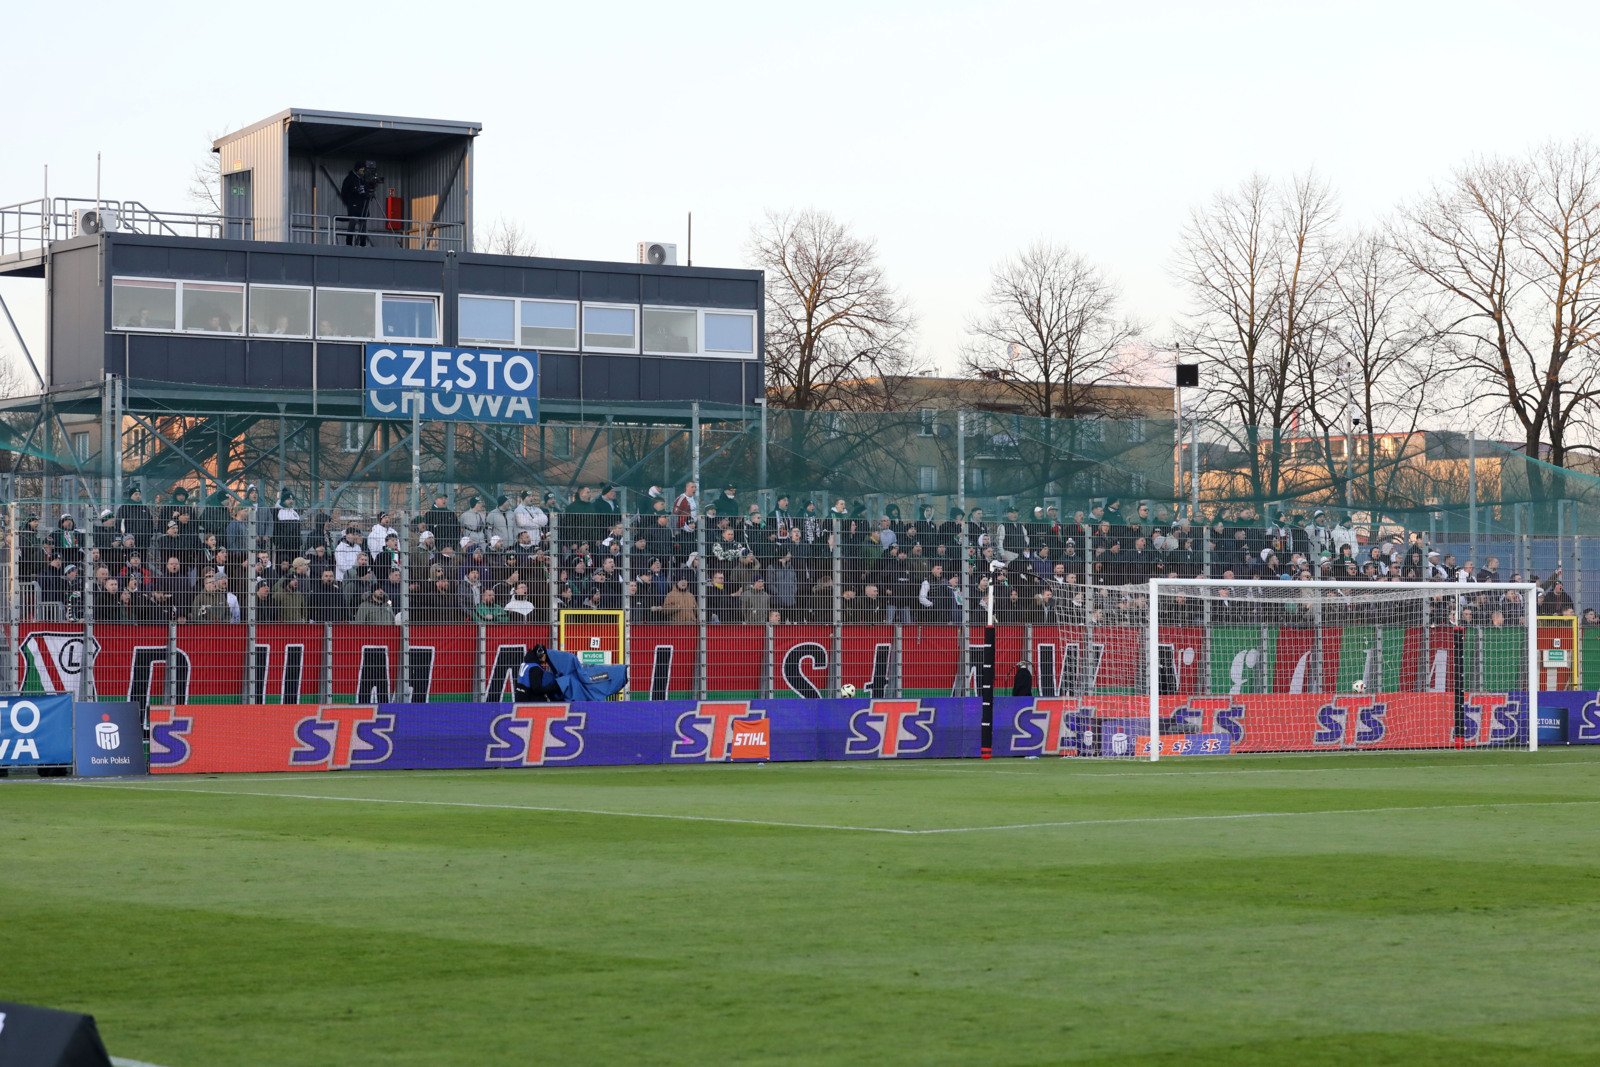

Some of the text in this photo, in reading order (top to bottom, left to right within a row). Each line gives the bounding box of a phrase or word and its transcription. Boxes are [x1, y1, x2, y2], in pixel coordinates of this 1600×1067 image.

[370, 349, 534, 393] CZĘSTO
[289, 704, 396, 769] STS
[485, 702, 586, 765] STS
[734, 732, 767, 747] STIHL
[845, 698, 936, 758] STS
[1313, 693, 1387, 748] STS
[91, 756, 131, 765] Bank Polski
[1143, 739, 1221, 753] SS STS STS
